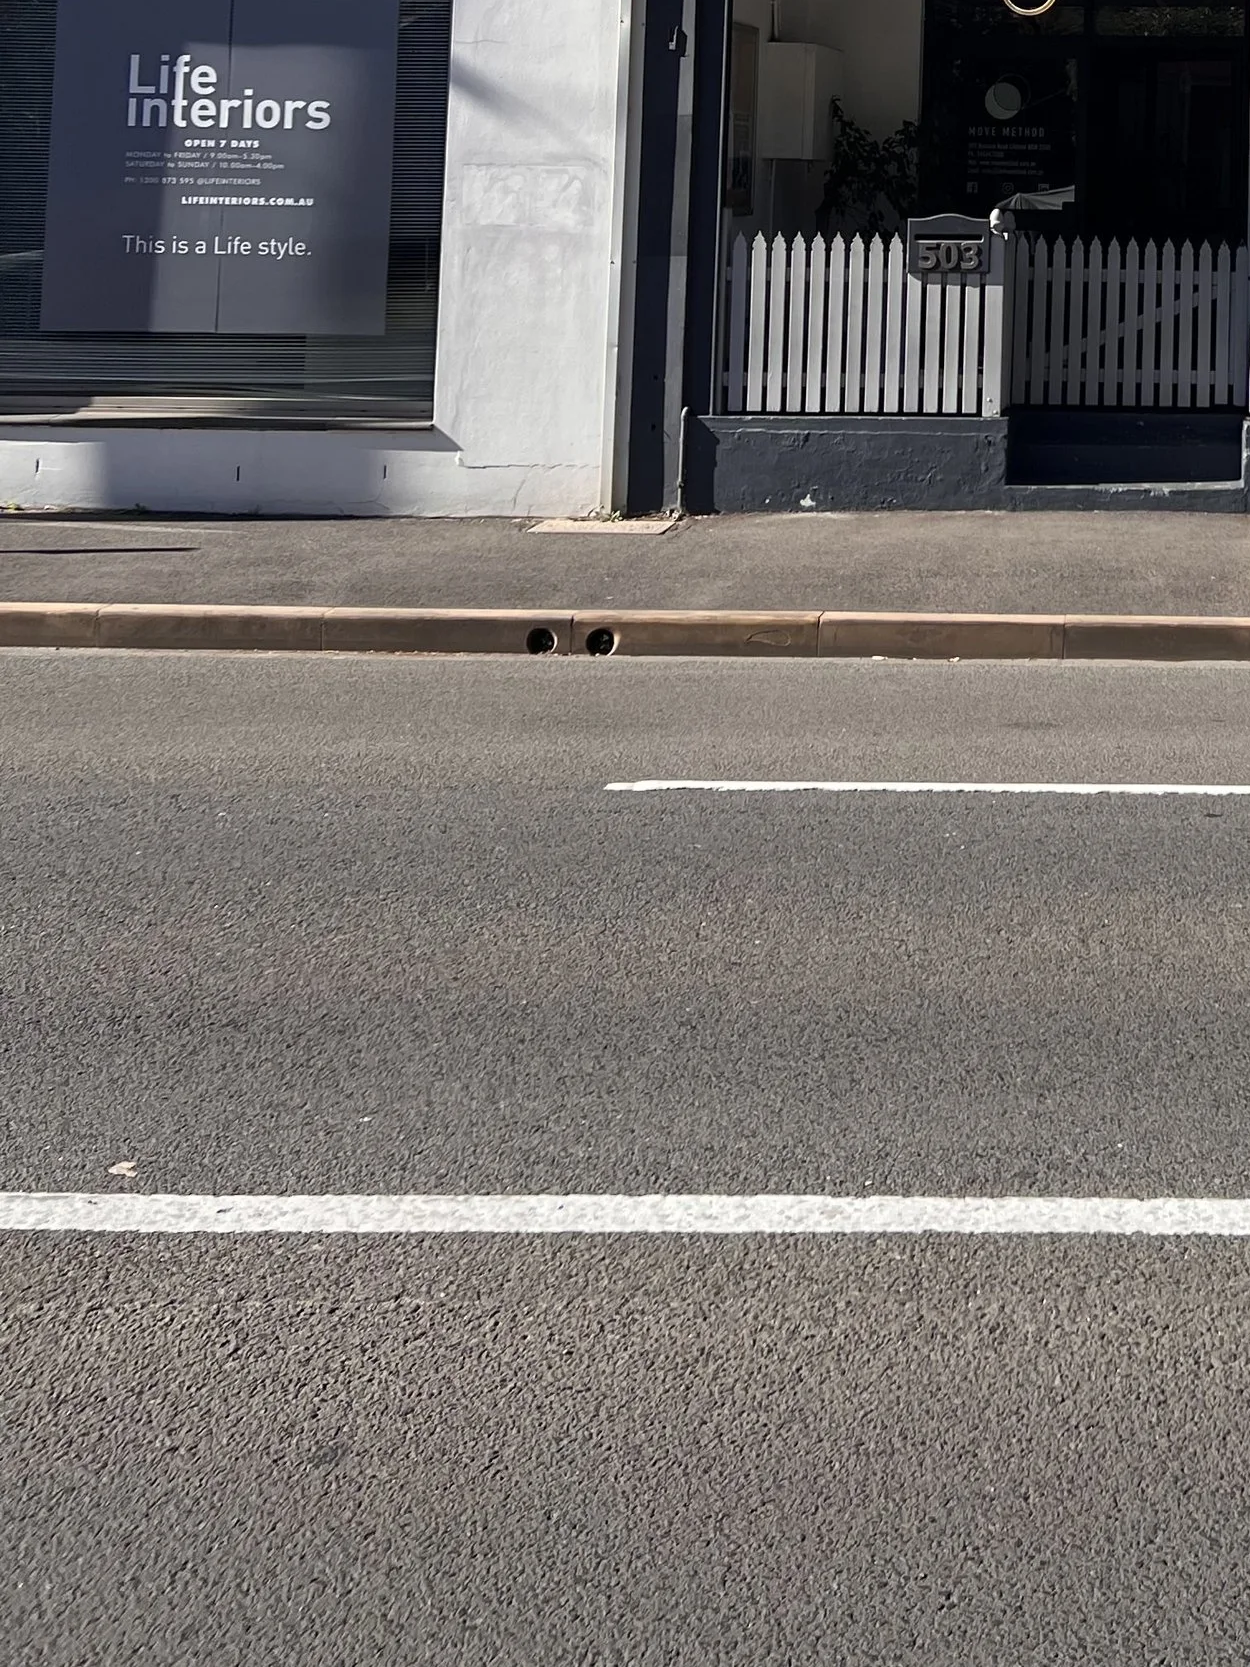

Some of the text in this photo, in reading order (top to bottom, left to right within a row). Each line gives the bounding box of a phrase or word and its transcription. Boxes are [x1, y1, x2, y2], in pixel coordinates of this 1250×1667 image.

[129, 54, 217, 96] Life
[127, 89, 331, 130] interiors
[968, 126, 1045, 138] MOVE METHOD
[184, 139, 260, 148] OPEN 7 DAYS
[125, 151, 162, 159] MONDAY
[177, 161, 210, 169] SUNDAY
[181, 196, 314, 206] LIFEINTERIORS.COM.AU
[122, 235, 312, 260] This is a Life style.
[918, 242, 979, 269] 503
